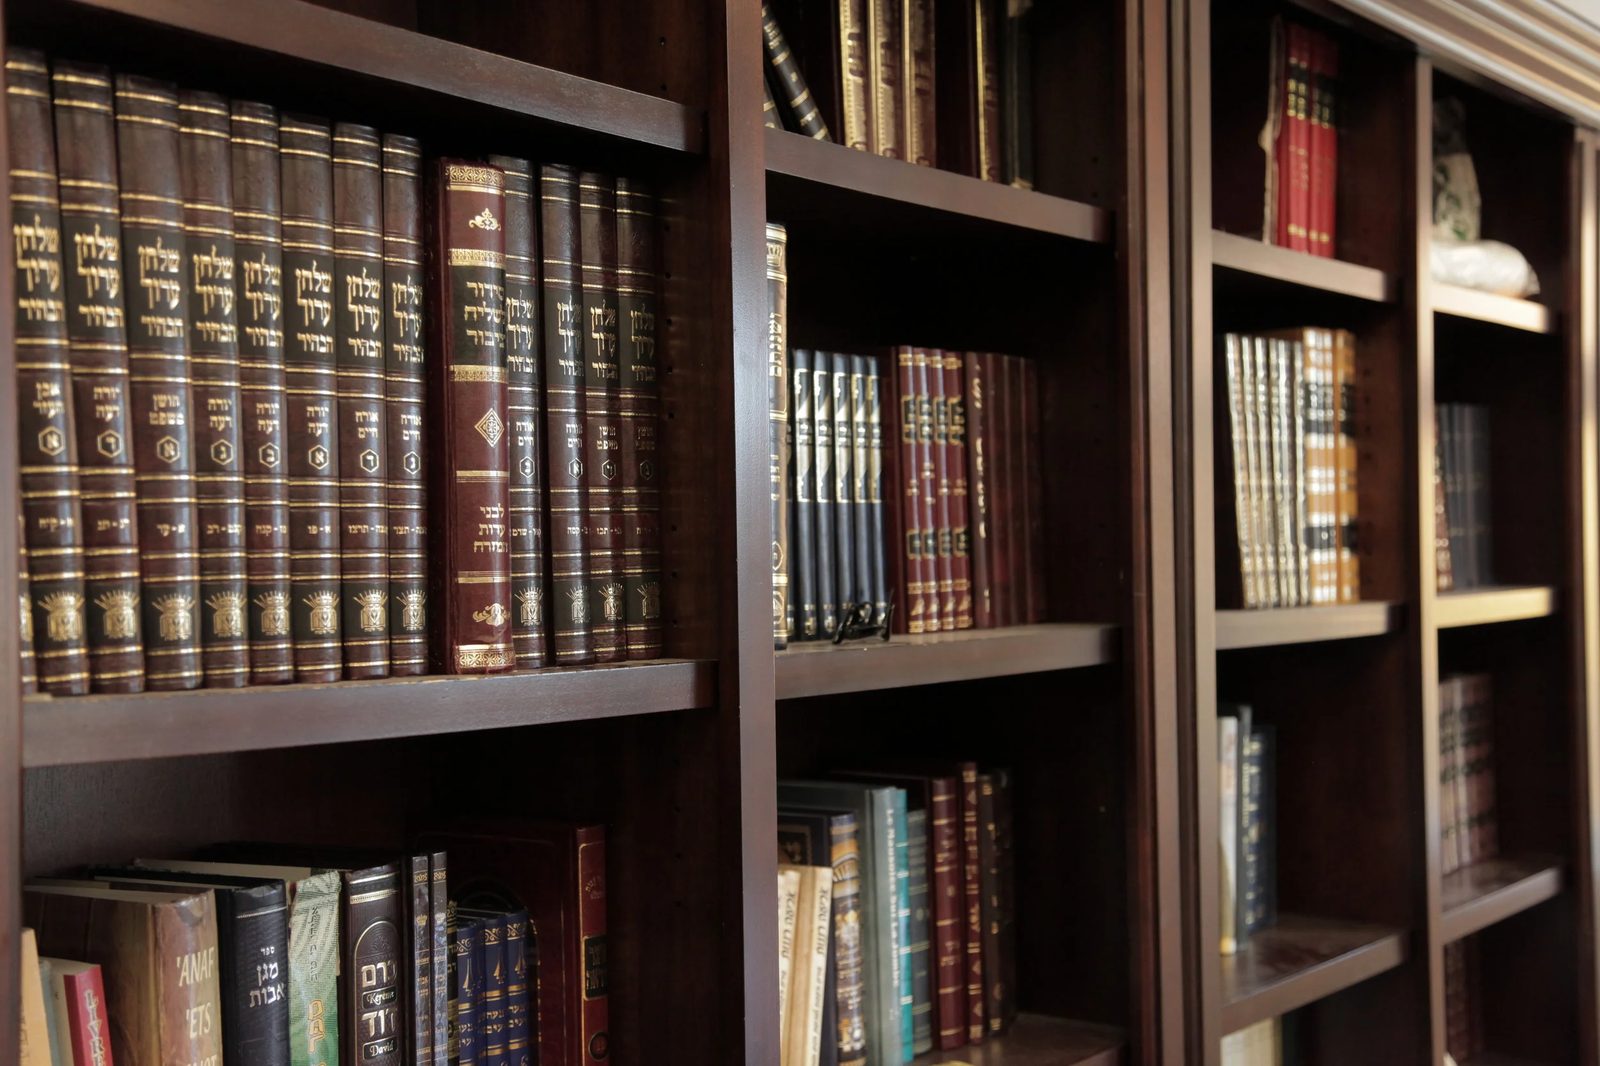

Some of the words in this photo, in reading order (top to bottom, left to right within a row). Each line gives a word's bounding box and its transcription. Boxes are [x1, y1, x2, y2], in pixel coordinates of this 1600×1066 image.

[13, 214, 59, 260] שלחן
[75, 223, 119, 265] שלחן
[138, 236, 180, 278] שלחן
[193, 244, 234, 282] שלחן
[17, 258, 59, 292] ערוך
[78, 266, 119, 299] ערוך
[243, 252, 281, 289] שלחן
[295, 260, 332, 297] שלחן
[140, 278, 181, 310] ערוך
[346, 267, 380, 303] שלחן
[392, 275, 423, 309] שלחן
[195, 284, 234, 316] ערוך
[245, 291, 281, 321] ערוך
[297, 298, 332, 327] ערוך
[506, 289, 534, 322] שלחן
[347, 304, 380, 332] ערוך
[393, 310, 422, 338] ערוך
[507, 323, 534, 350] ערוך
[93, 386, 120, 400] יורה
[153, 394, 180, 411] חושן
[207, 398, 232, 411] יורה
[96, 405, 120, 422] דעה
[149, 412, 184, 425] משפט
[256, 402, 280, 415] יורה
[306, 406, 329, 418] יורה
[355, 411, 379, 423] אורח
[400, 414, 422, 426] אורח
[210, 416, 232, 431] דעה
[257, 419, 279, 435] דעה
[308, 422, 329, 437] דעה
[357, 427, 379, 439] חיים
[402, 429, 421, 441] חיים
[516, 421, 535, 432] אורח
[518, 436, 535, 447] חיים
[479, 504, 505, 519] לבני
[478, 523, 505, 538] עדות
[473, 541, 508, 553] המזרח
[260, 946, 275, 956] ספר
[176, 946, 215, 987] 'ANAF
[256, 961, 279, 987] מגן
[361, 960, 397, 988] כרם
[249, 982, 286, 1008] אבות
[186, 1002, 211, 1040] 'ETS
[369, 1039, 394, 1057] David
